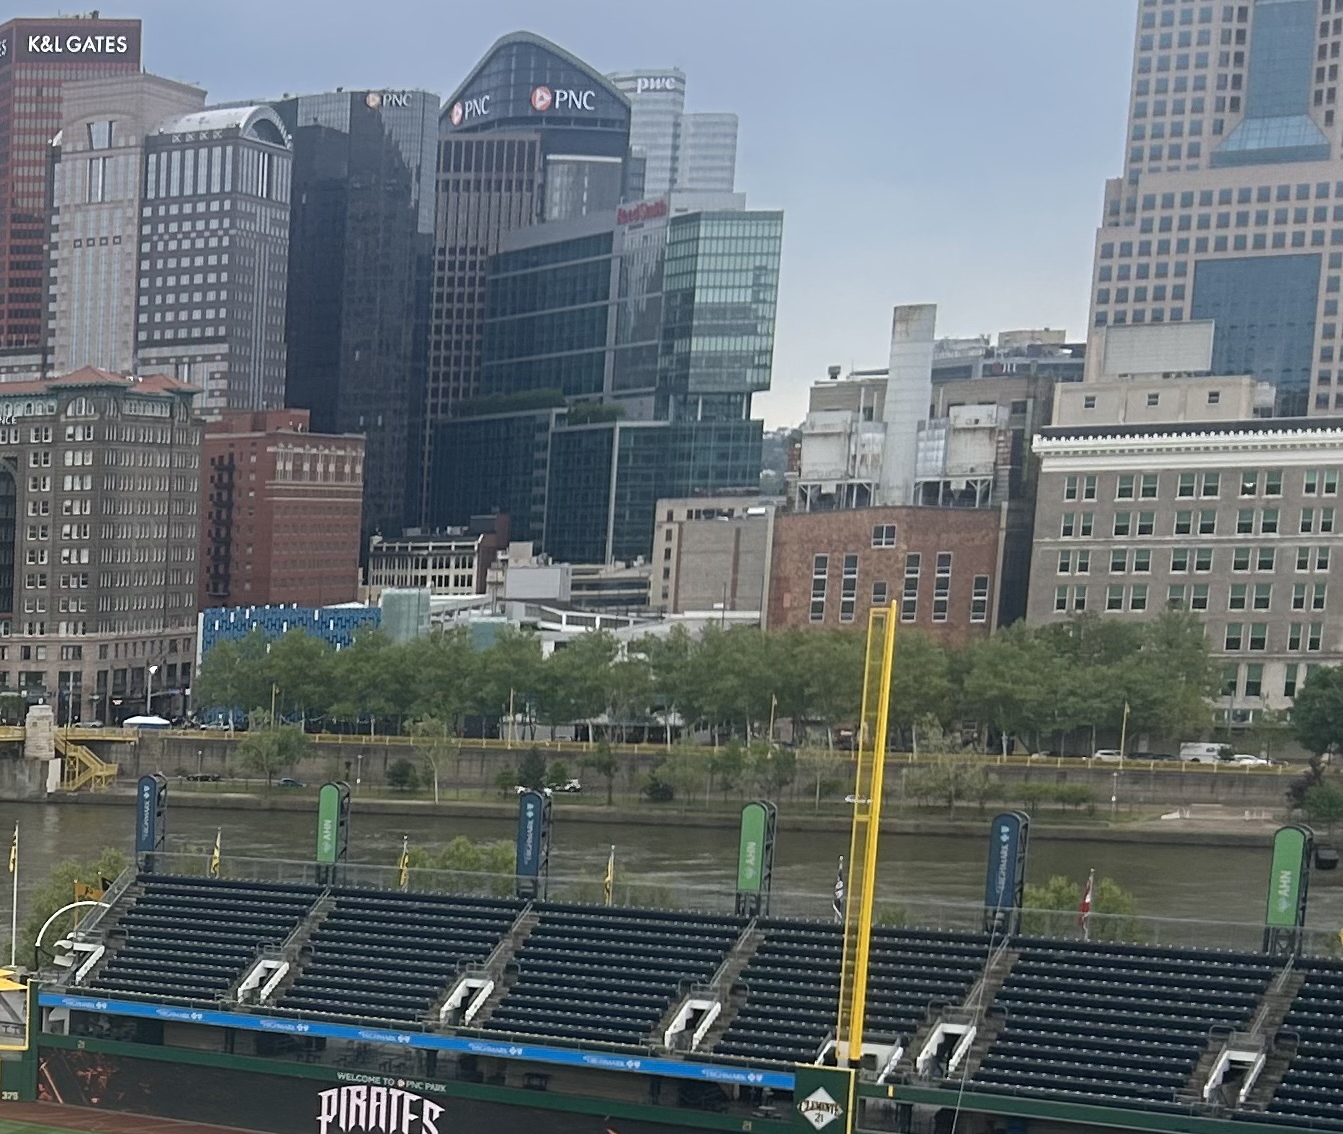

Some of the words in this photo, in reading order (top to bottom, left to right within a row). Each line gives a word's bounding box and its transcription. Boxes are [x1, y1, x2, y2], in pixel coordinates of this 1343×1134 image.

[28, 35, 62, 53] K&L
[66, 35, 127, 53] GATES
[636, 77, 676, 94] pwc
[381, 93, 412, 107] PNC
[464, 95, 490, 120] PNC
[555, 90, 596, 111] PNC
[1281, 870, 1291, 897] AHN
[337, 1072, 381, 1084] WELCOME
[383, 1077, 395, 1087] TO
[406, 1080, 424, 1090] PNC
[425, 1082, 446, 1092] PARK
